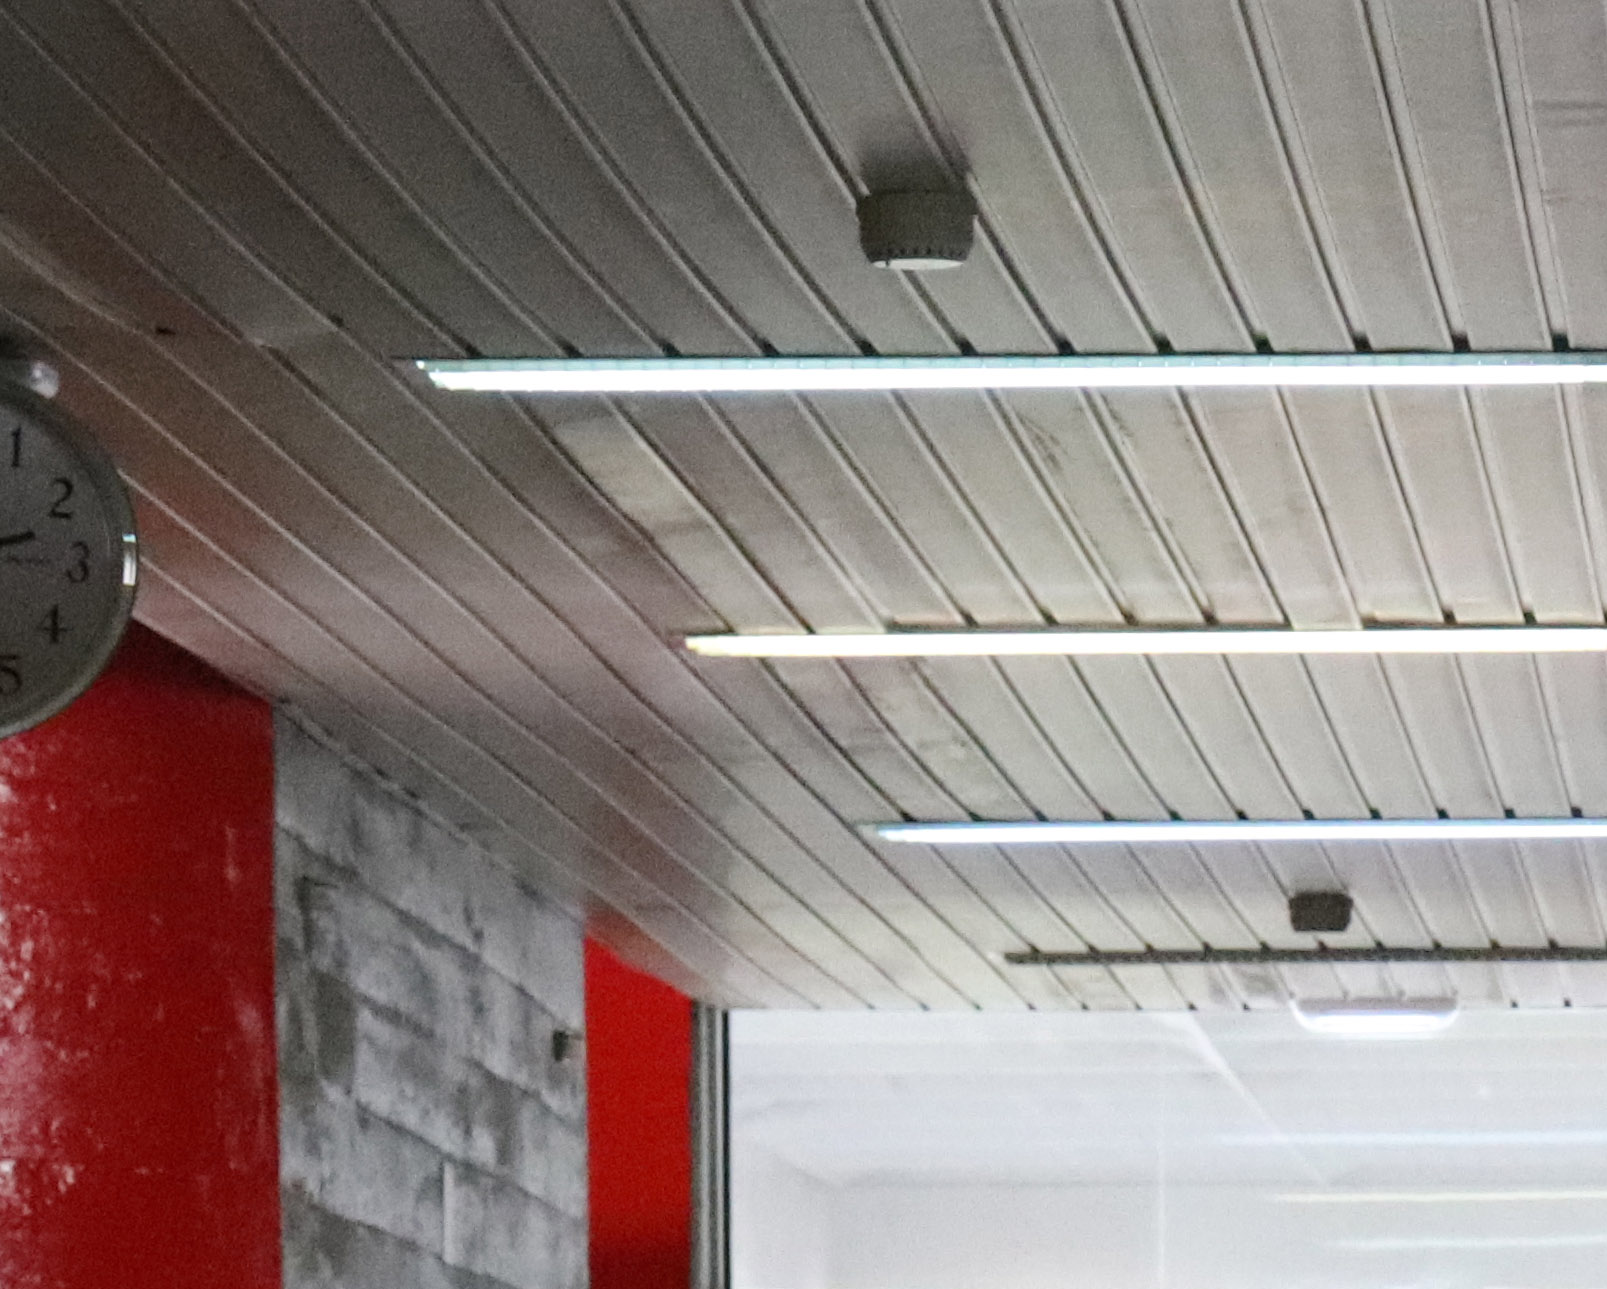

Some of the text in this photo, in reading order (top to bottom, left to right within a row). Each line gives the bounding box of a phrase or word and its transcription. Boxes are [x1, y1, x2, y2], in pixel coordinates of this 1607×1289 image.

[9, 425, 24, 468] 1
[48, 477, 74, 520] 2
[66, 541, 90, 584] 3
[41, 603, 72, 646] 4
